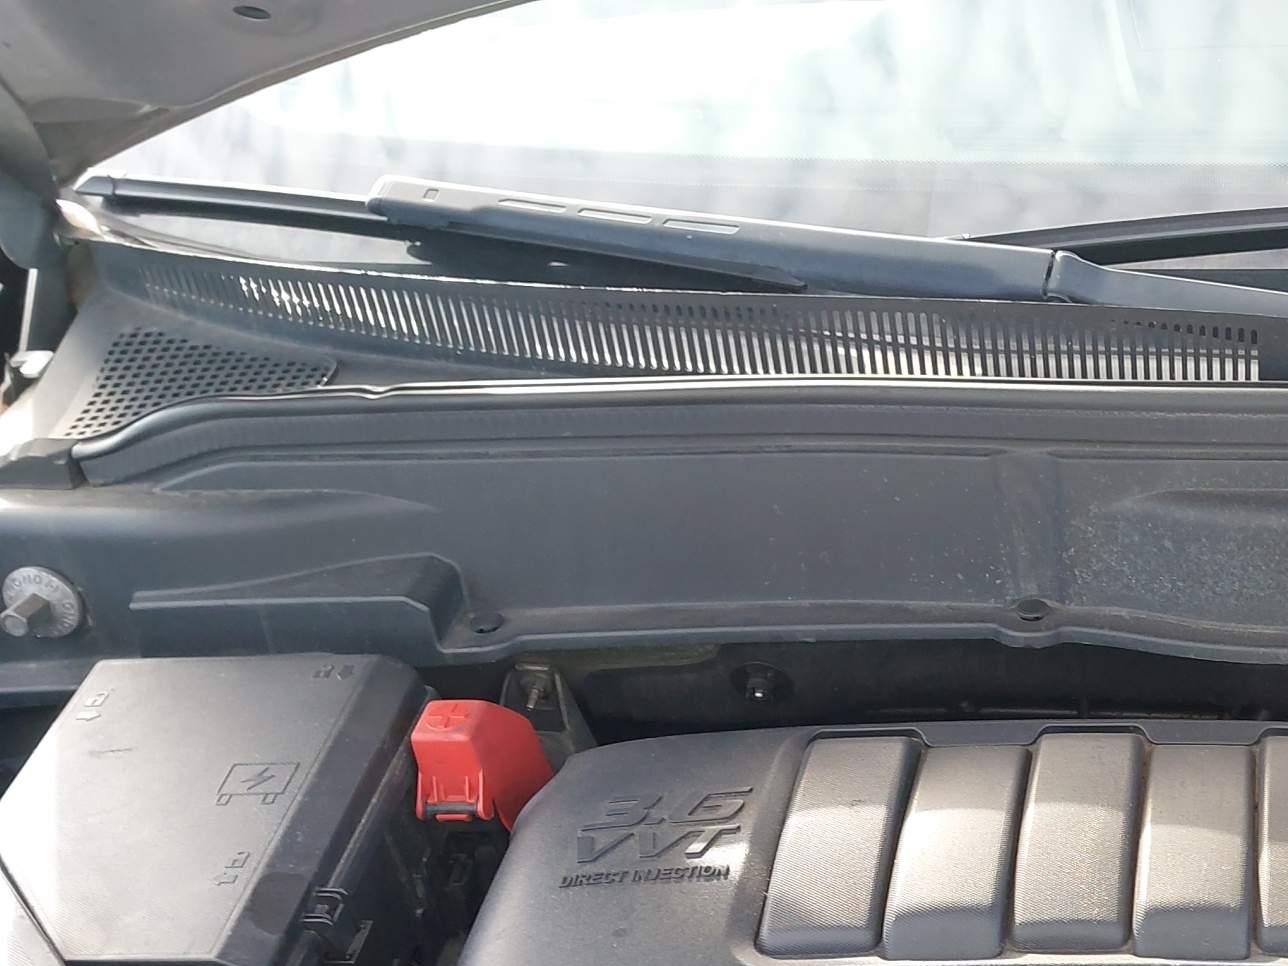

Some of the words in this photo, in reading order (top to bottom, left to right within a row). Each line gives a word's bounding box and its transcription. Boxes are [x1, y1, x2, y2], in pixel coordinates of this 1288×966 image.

[580, 786, 753, 833] 3.6
[576, 824, 741, 864] VVT
[558, 871, 629, 889] DIRECT
[631, 864, 731, 885] INJECTION
